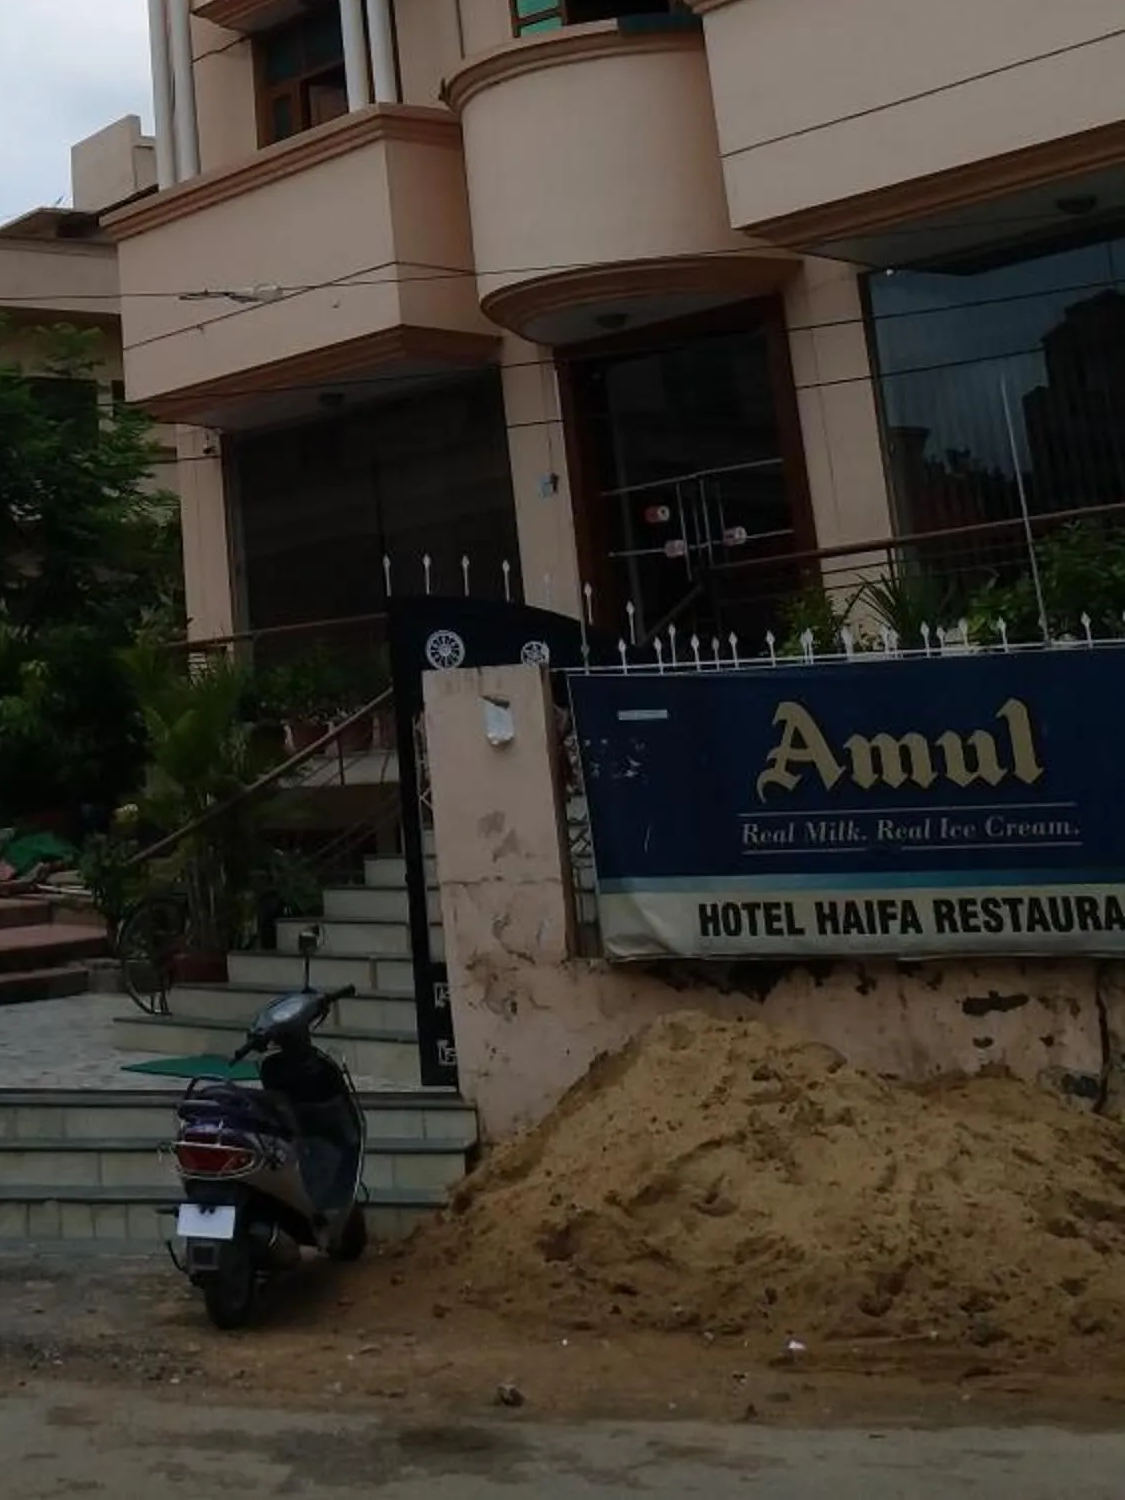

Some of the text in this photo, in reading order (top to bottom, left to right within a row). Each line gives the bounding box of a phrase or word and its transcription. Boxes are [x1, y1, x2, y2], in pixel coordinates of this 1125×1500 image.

[756, 695, 1046, 805] Amul
[741, 813, 1083, 847] Real Milk. Real Ice Cream.
[697, 900, 805, 937] HOTEL
[814, 898, 924, 936] HAIFA
